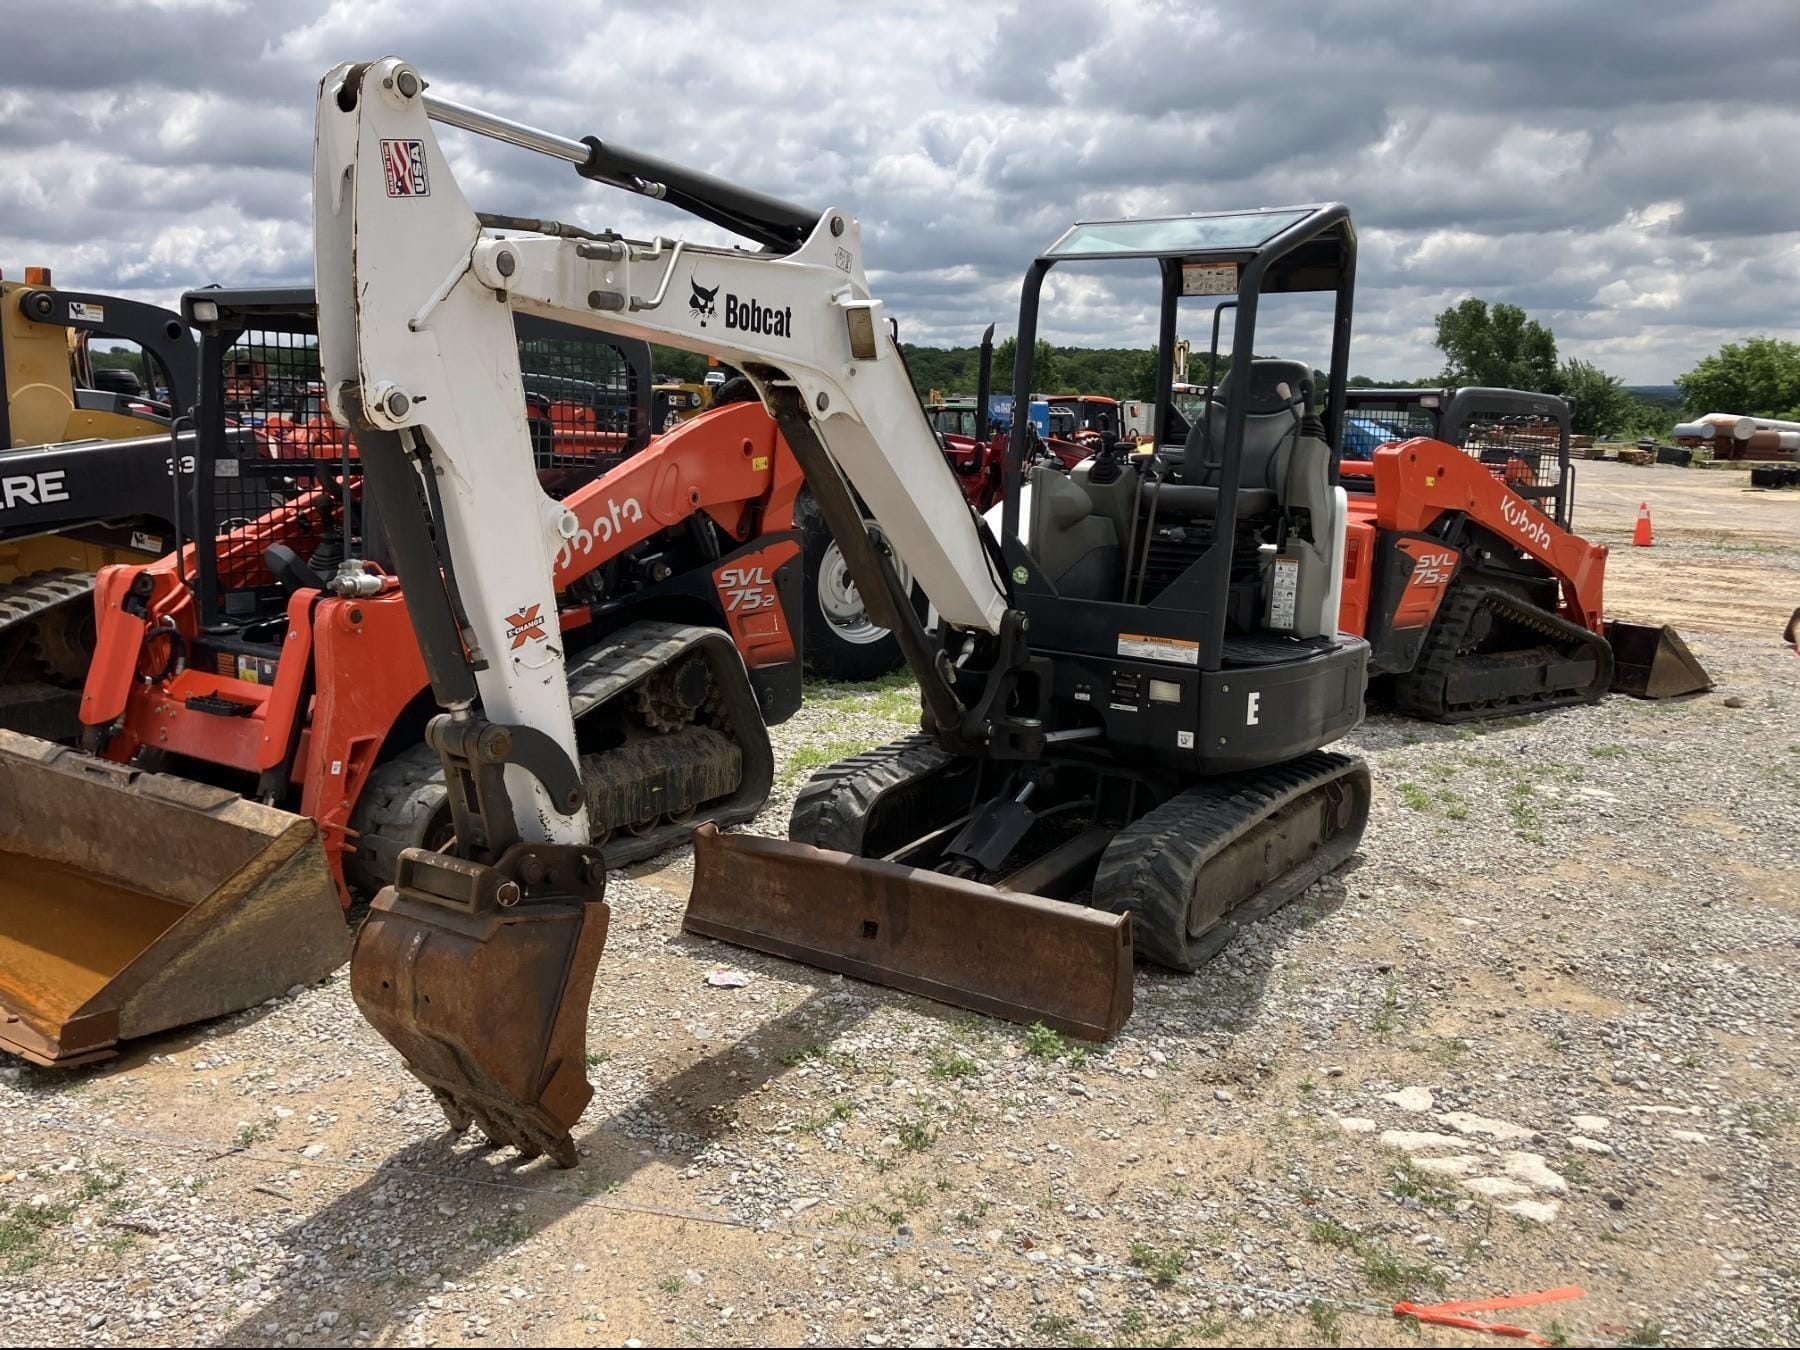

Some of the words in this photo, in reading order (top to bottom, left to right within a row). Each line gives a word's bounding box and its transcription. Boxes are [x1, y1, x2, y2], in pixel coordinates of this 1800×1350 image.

[410, 146, 425, 193] USA
[726, 293, 791, 338] Bobcat
[0, 470, 70, 509] RE
[552, 498, 643, 575] ubota
[1500, 494, 1550, 551] Kubota
[718, 567, 772, 589] SVL
[1415, 553, 1455, 569] SVL
[727, 588, 775, 612] 75-2
[1247, 692, 1260, 726] E
